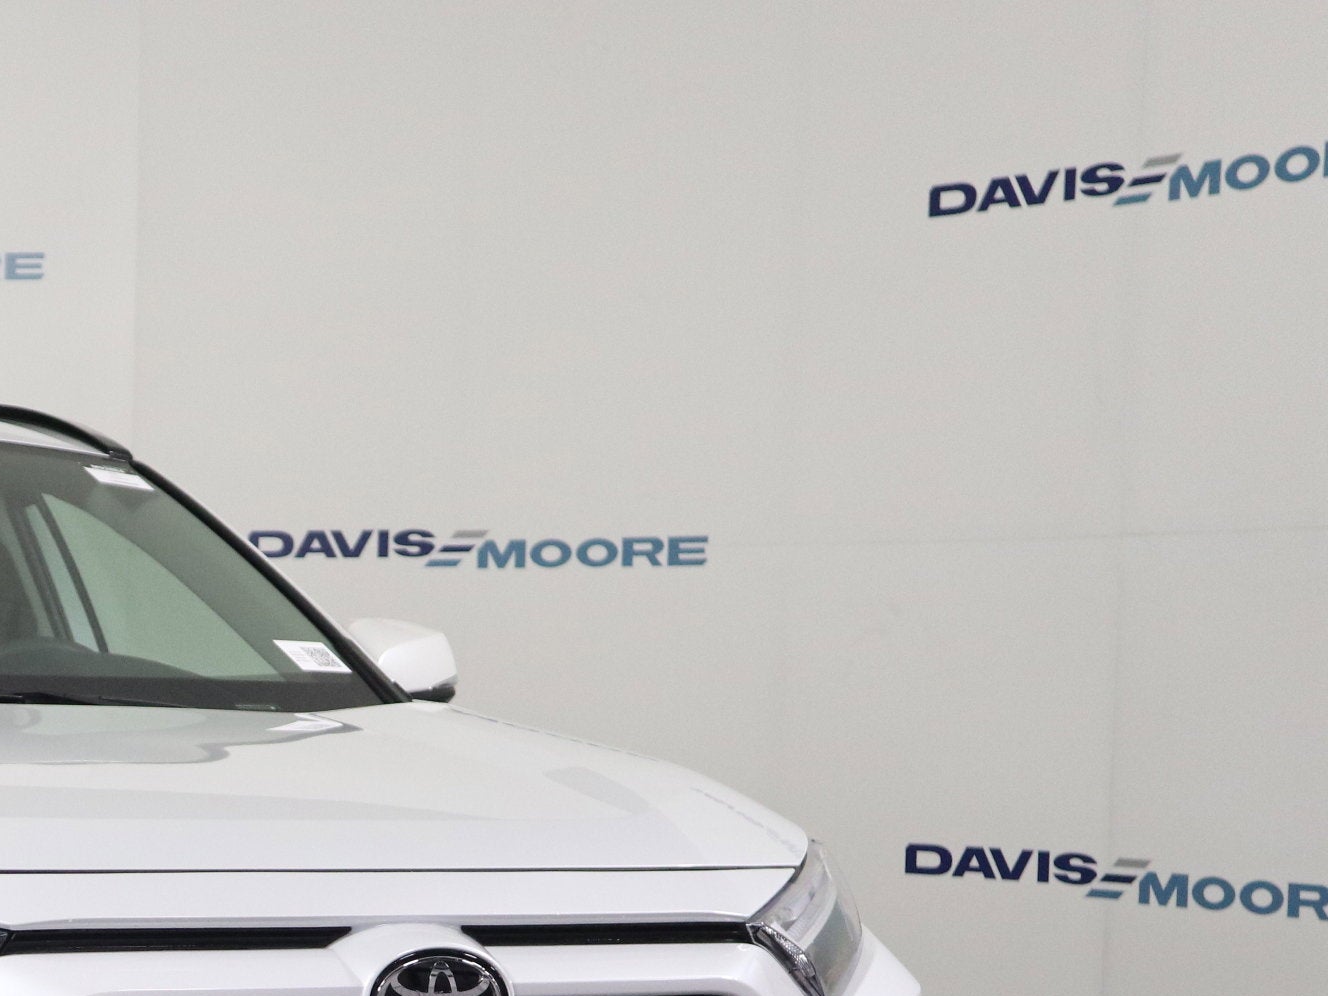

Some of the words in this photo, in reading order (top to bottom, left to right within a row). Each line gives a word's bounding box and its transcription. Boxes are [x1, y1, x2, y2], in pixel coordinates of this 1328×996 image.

[928, 161, 1126, 218] DAVIS
[1168, 140, 1328, 202] MOO
[247, 529, 436, 558] DAVIS
[477, 535, 709, 569] MOORE
[904, 842, 1098, 886] DAVIS
